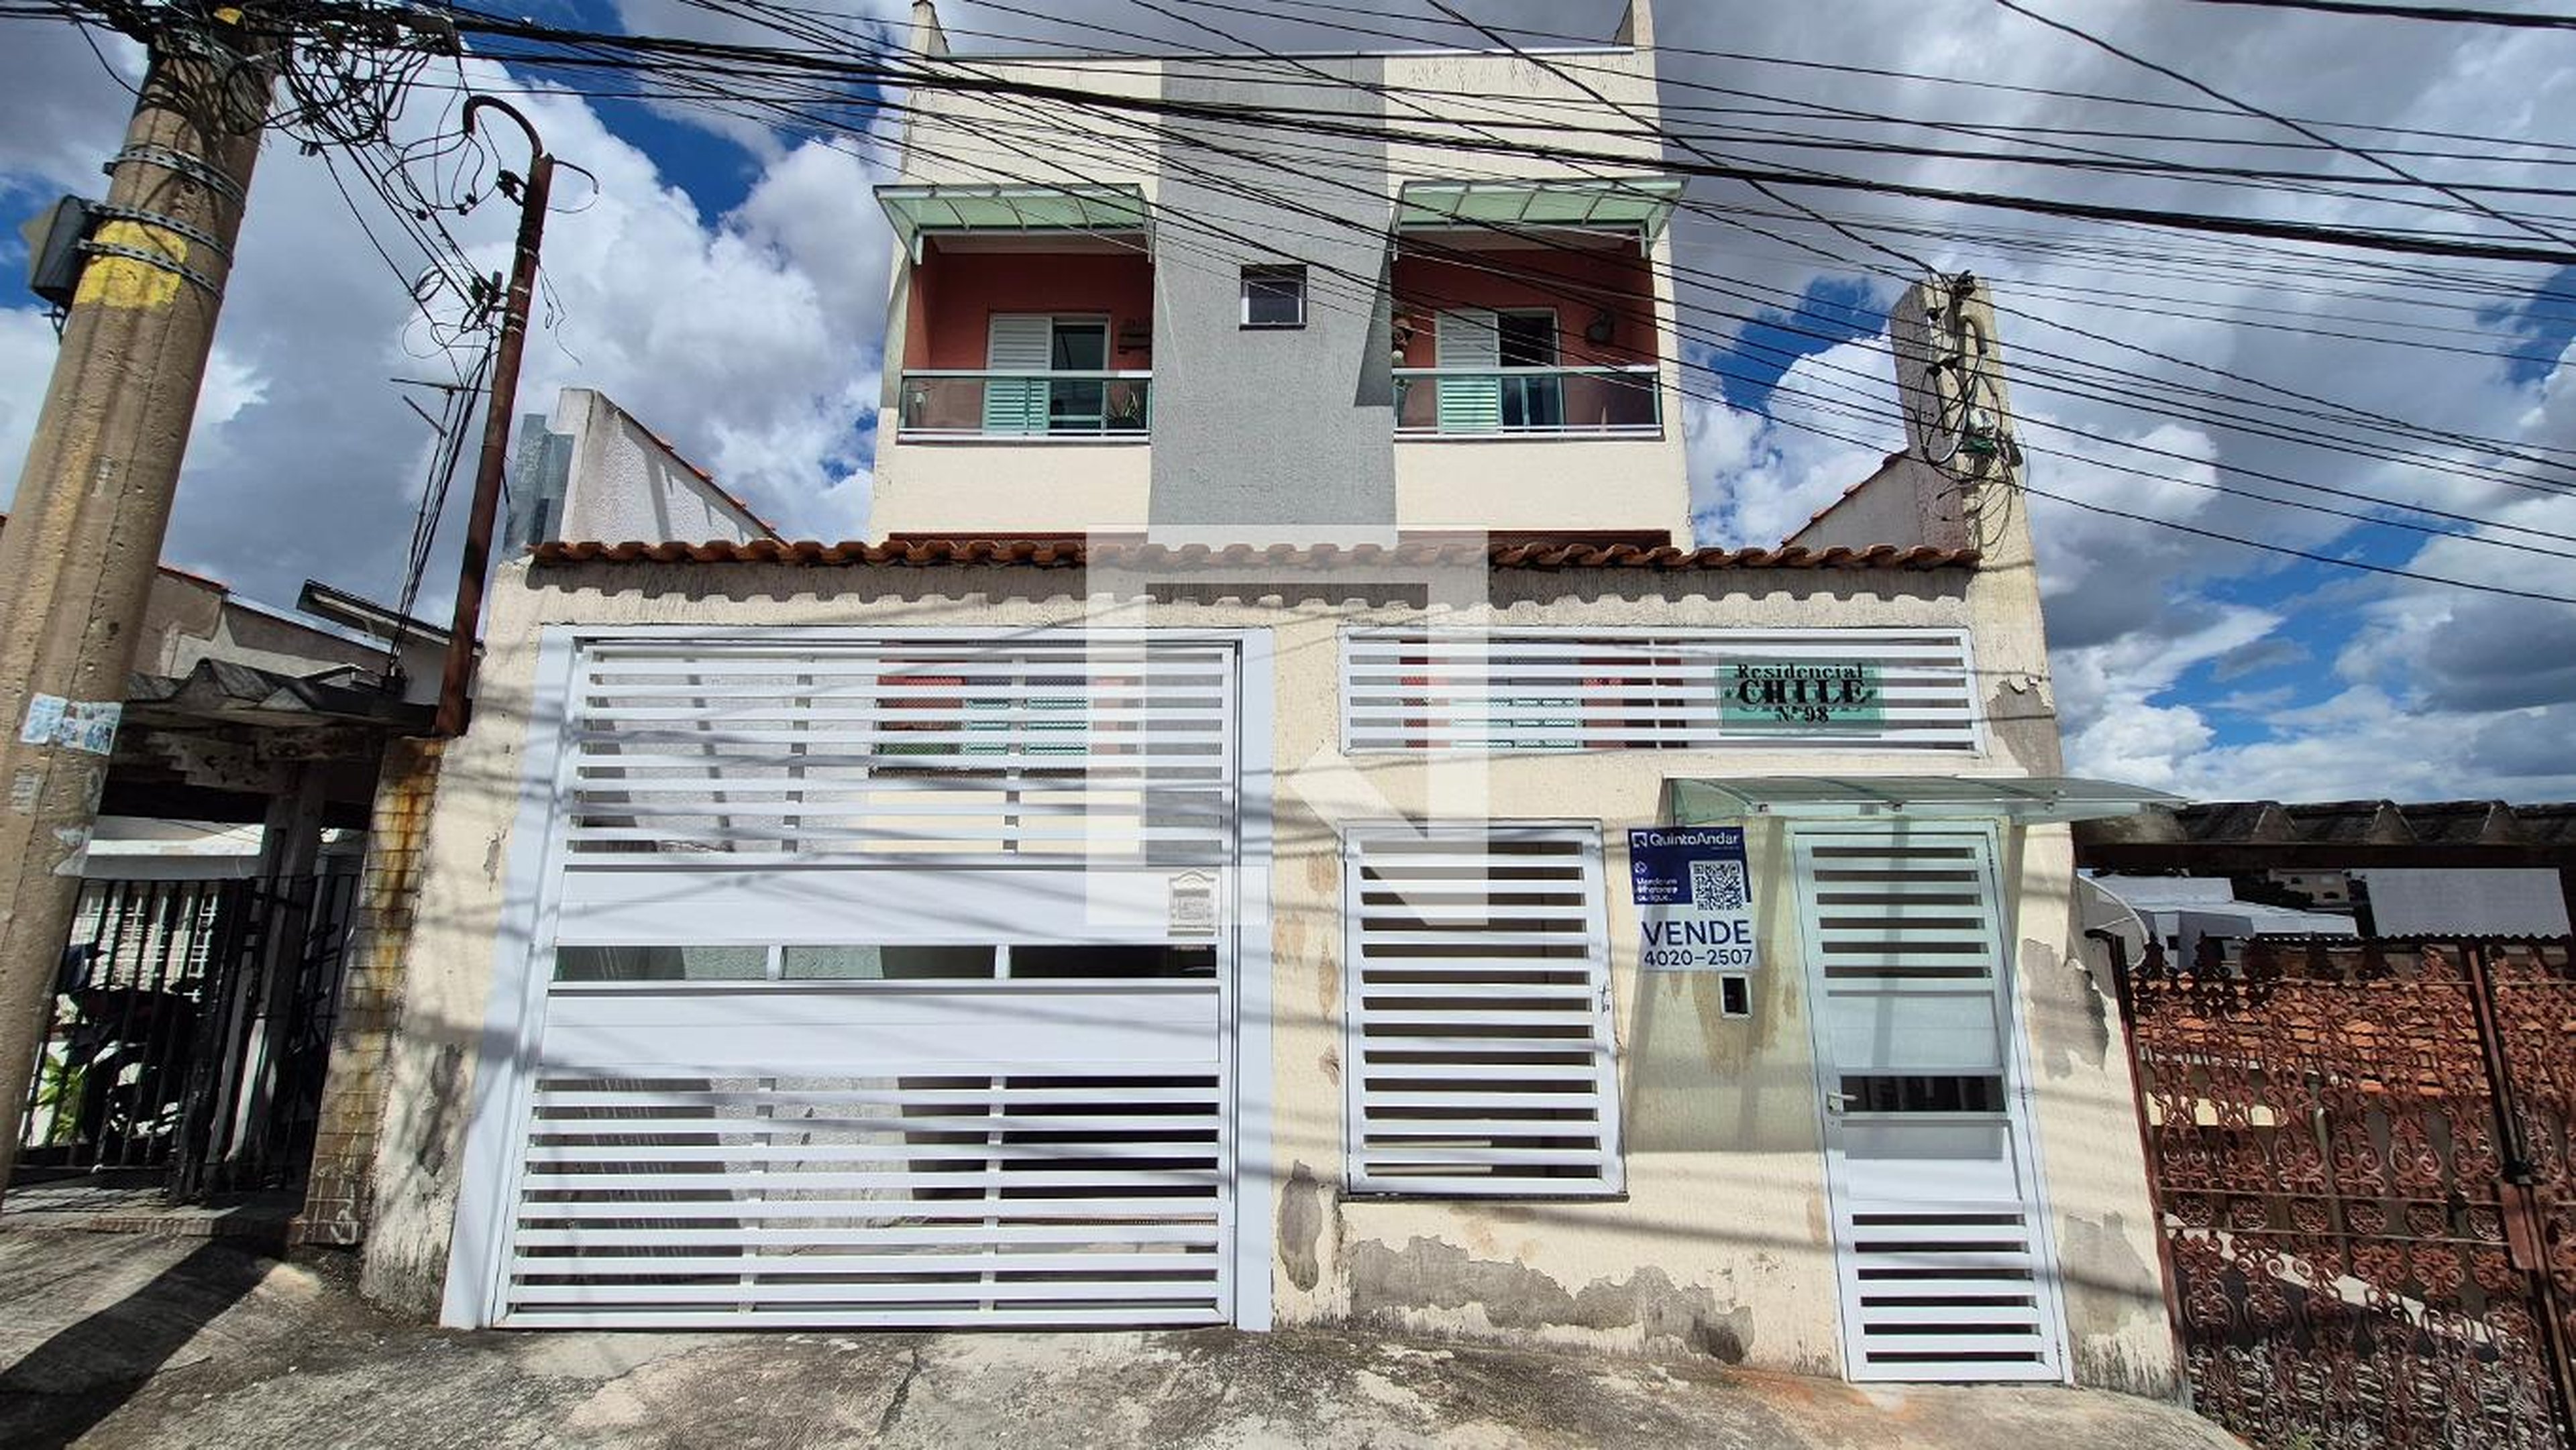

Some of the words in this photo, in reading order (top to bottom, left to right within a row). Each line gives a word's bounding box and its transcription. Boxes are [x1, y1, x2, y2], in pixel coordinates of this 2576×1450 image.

[1737, 663, 1862, 679] Residencial
[1738, 679, 1866, 705] CHILE
[1650, 832, 1737, 846] QuintoAndar
[1642, 919, 1752, 946] VENDE
[1644, 949, 1753, 966] 4020-2507
